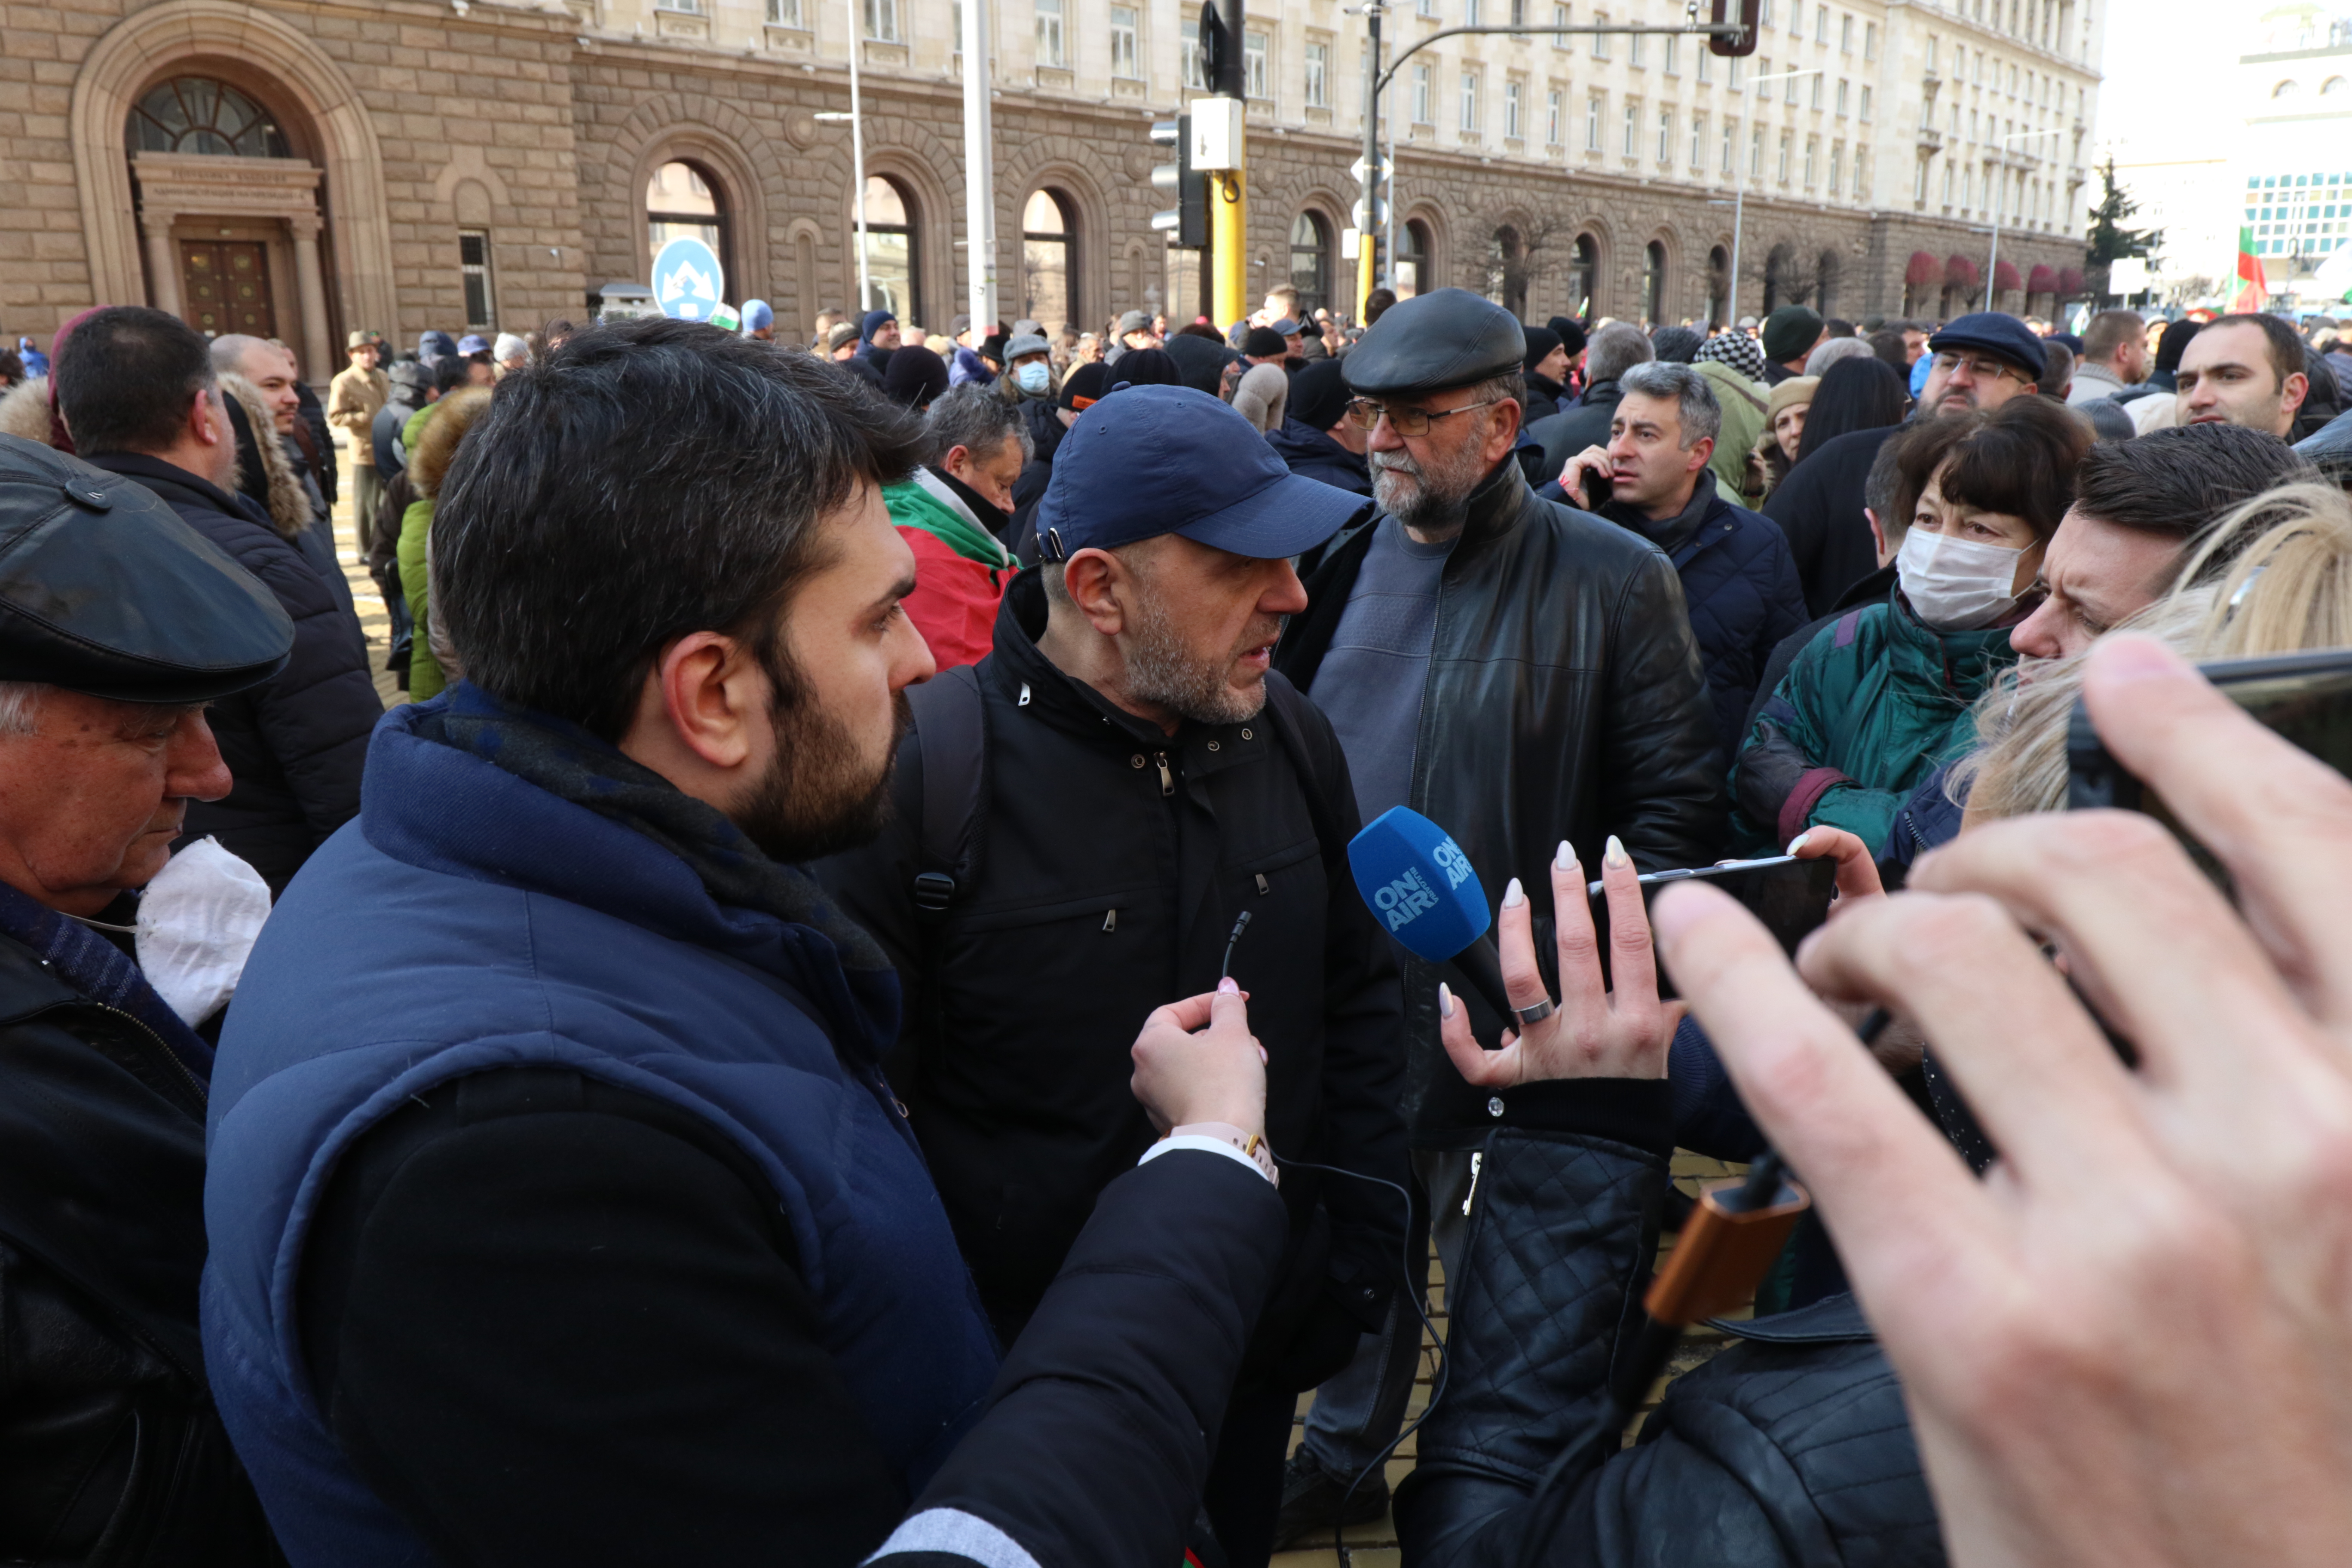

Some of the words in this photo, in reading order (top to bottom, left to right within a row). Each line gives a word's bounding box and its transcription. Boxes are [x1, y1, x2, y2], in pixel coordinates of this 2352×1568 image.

[1433, 837, 1460, 867] ON
[1375, 871, 1420, 910] ON
[1409, 867, 1439, 903] BULGARIA
[1446, 855, 1472, 891] AIR
[1386, 890, 1436, 932] AIR
